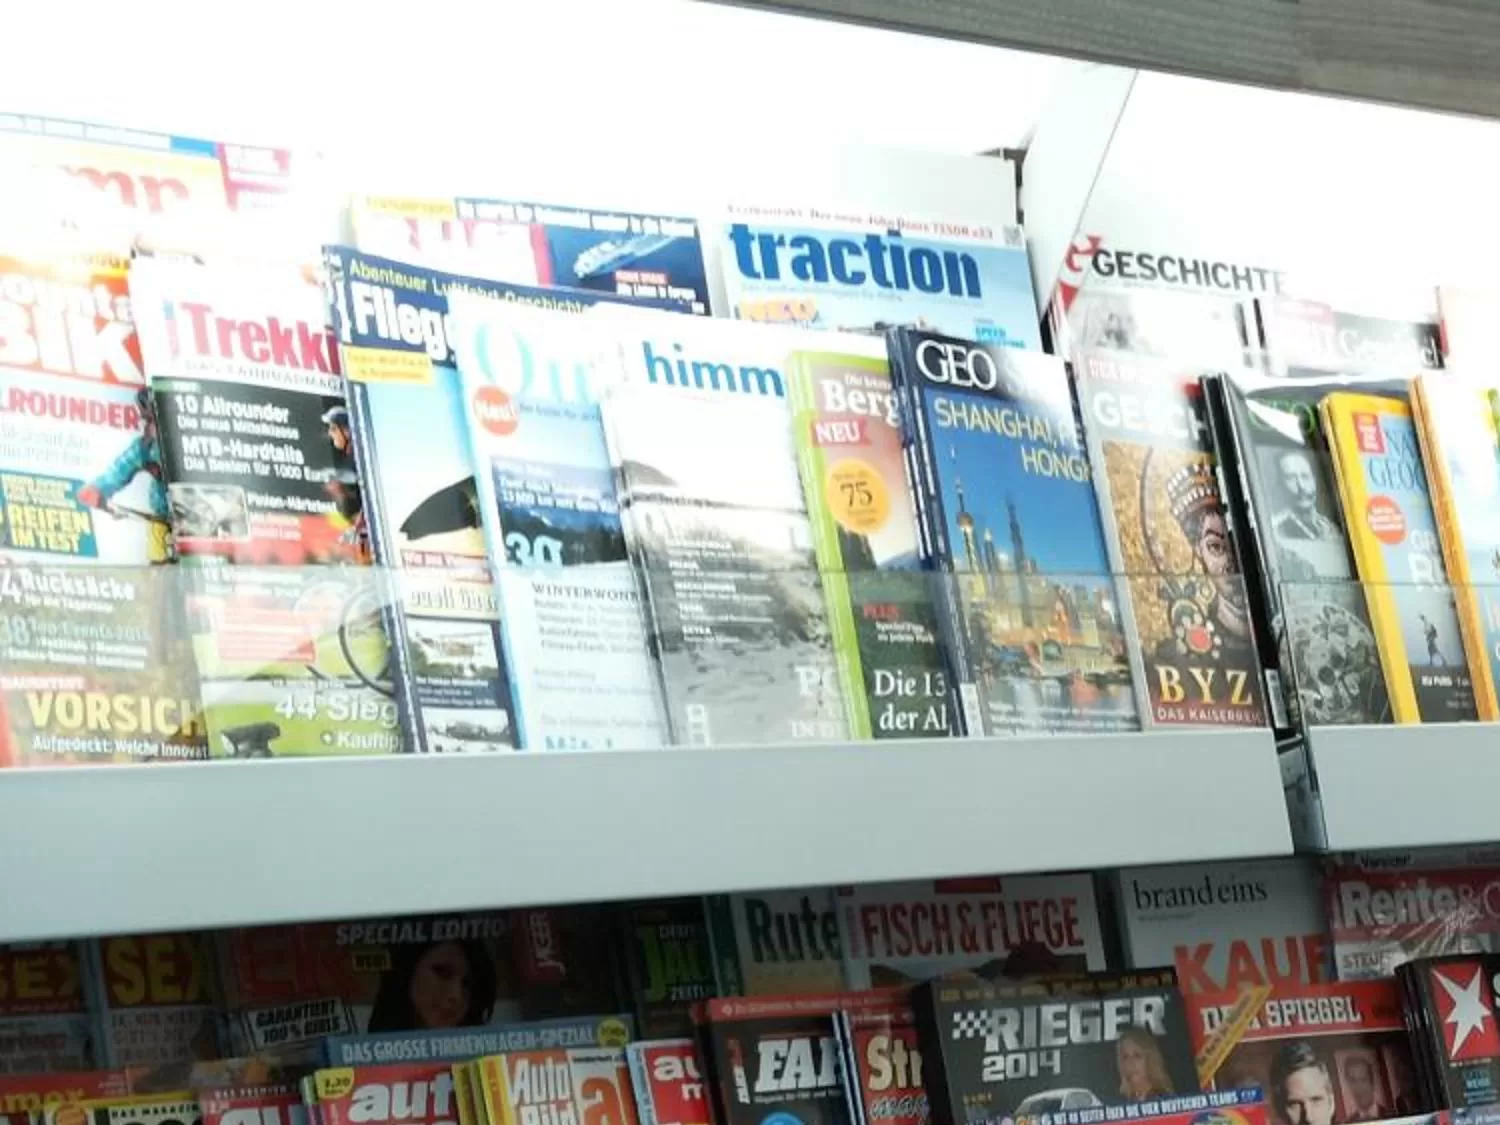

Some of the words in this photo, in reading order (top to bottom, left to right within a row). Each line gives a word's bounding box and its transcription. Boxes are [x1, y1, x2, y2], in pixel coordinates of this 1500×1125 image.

[351, 259, 428, 292] Abenteuer
[730, 222, 982, 299] traction
[915, 339, 997, 392] GEO
[814, 421, 862, 444] NEU
[840, 483, 874, 507] 75
[9, 504, 91, 534] REIFEN
[874, 669, 917, 697] Die
[879, 706, 919, 730] der
[747, 898, 838, 963] Rute
[863, 900, 954, 957] FISCH
[958, 904, 981, 954] &
[986, 999, 1168, 1052] RIEGER
[1266, 996, 1361, 1028] SPIEGEL
[341, 1043, 372, 1063] DAS
[373, 1040, 428, 1061] GROSSE
[982, 1052, 1062, 1082] 2014
[512, 1059, 569, 1103] Auto
